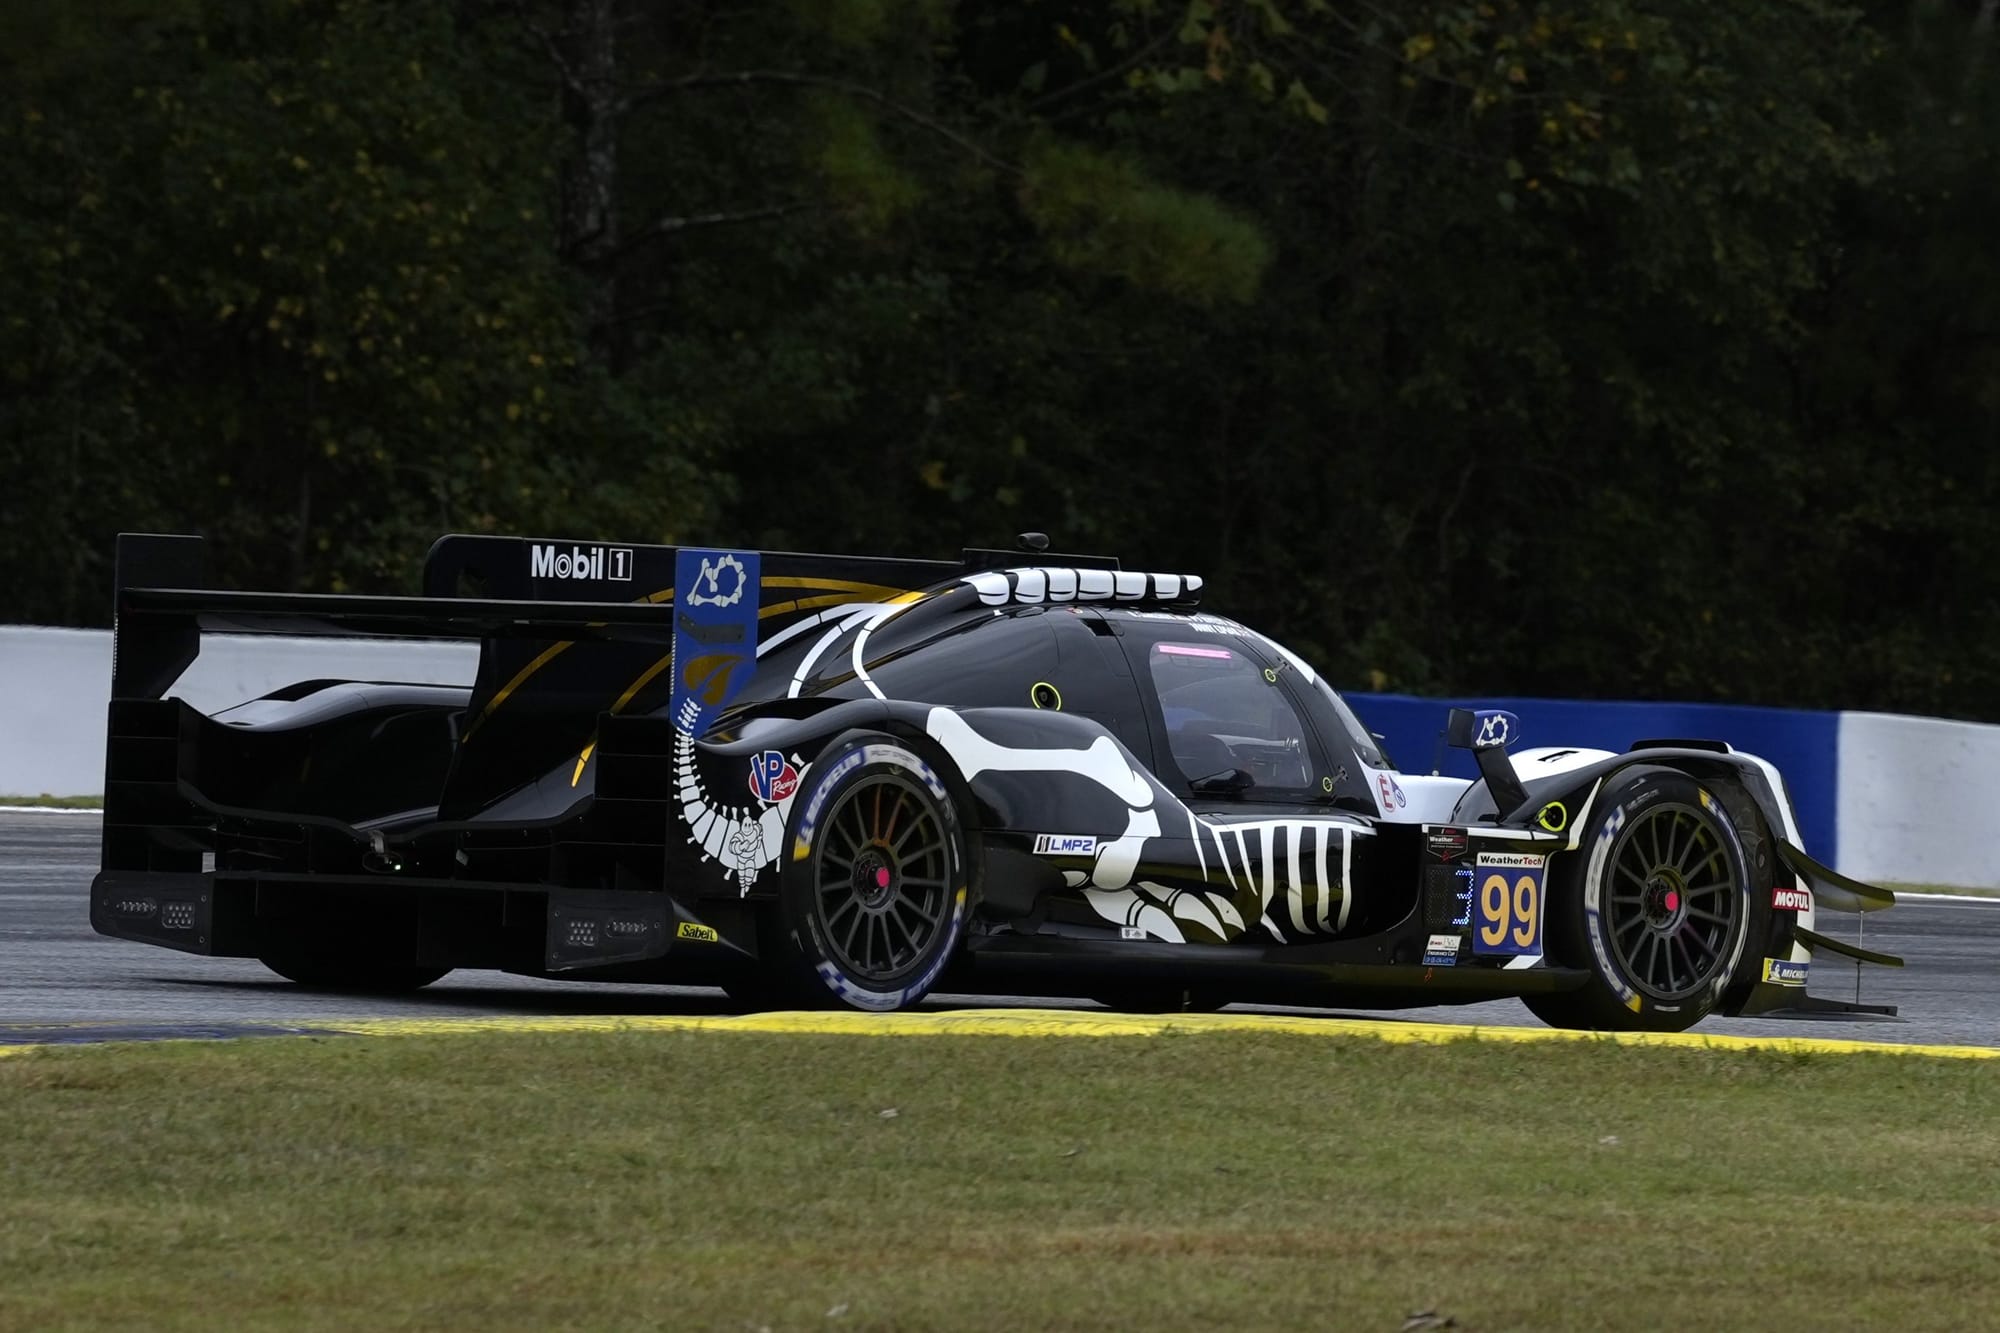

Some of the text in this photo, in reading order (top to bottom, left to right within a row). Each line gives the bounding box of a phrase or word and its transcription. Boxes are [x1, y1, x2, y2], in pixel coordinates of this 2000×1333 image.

[531, 545, 604, 580] Mobil
[750, 751, 785, 802] VP
[773, 779, 797, 797] Racing
[1050, 838, 1094, 852] LMP2
[1480, 855, 1543, 866] WeatherTech
[1774, 891, 1809, 909] MOTUL
[1480, 874, 1538, 948] 99
[682, 924, 714, 941] Sabelt
